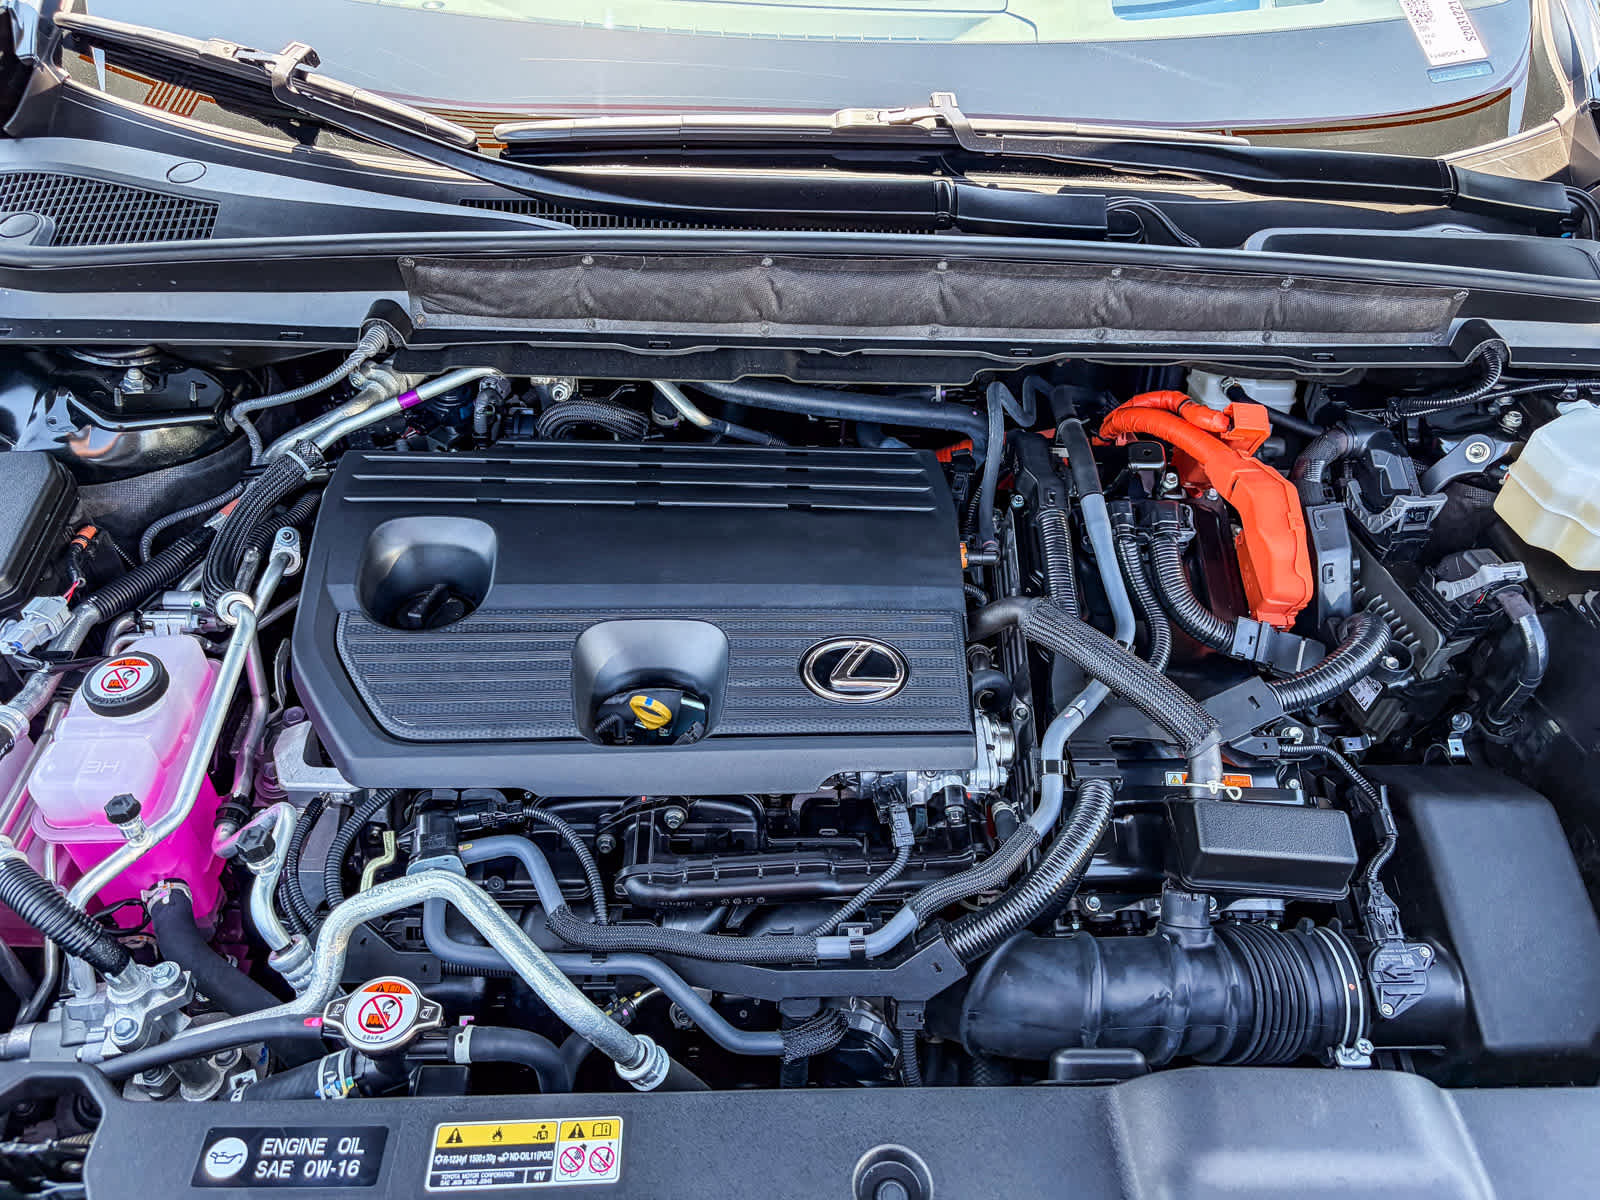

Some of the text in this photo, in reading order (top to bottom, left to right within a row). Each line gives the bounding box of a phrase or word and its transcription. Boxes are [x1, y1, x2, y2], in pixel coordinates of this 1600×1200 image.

[260, 1137, 365, 1156] ENGINE OIL
[255, 1159, 361, 1179] SAE 0W-16
